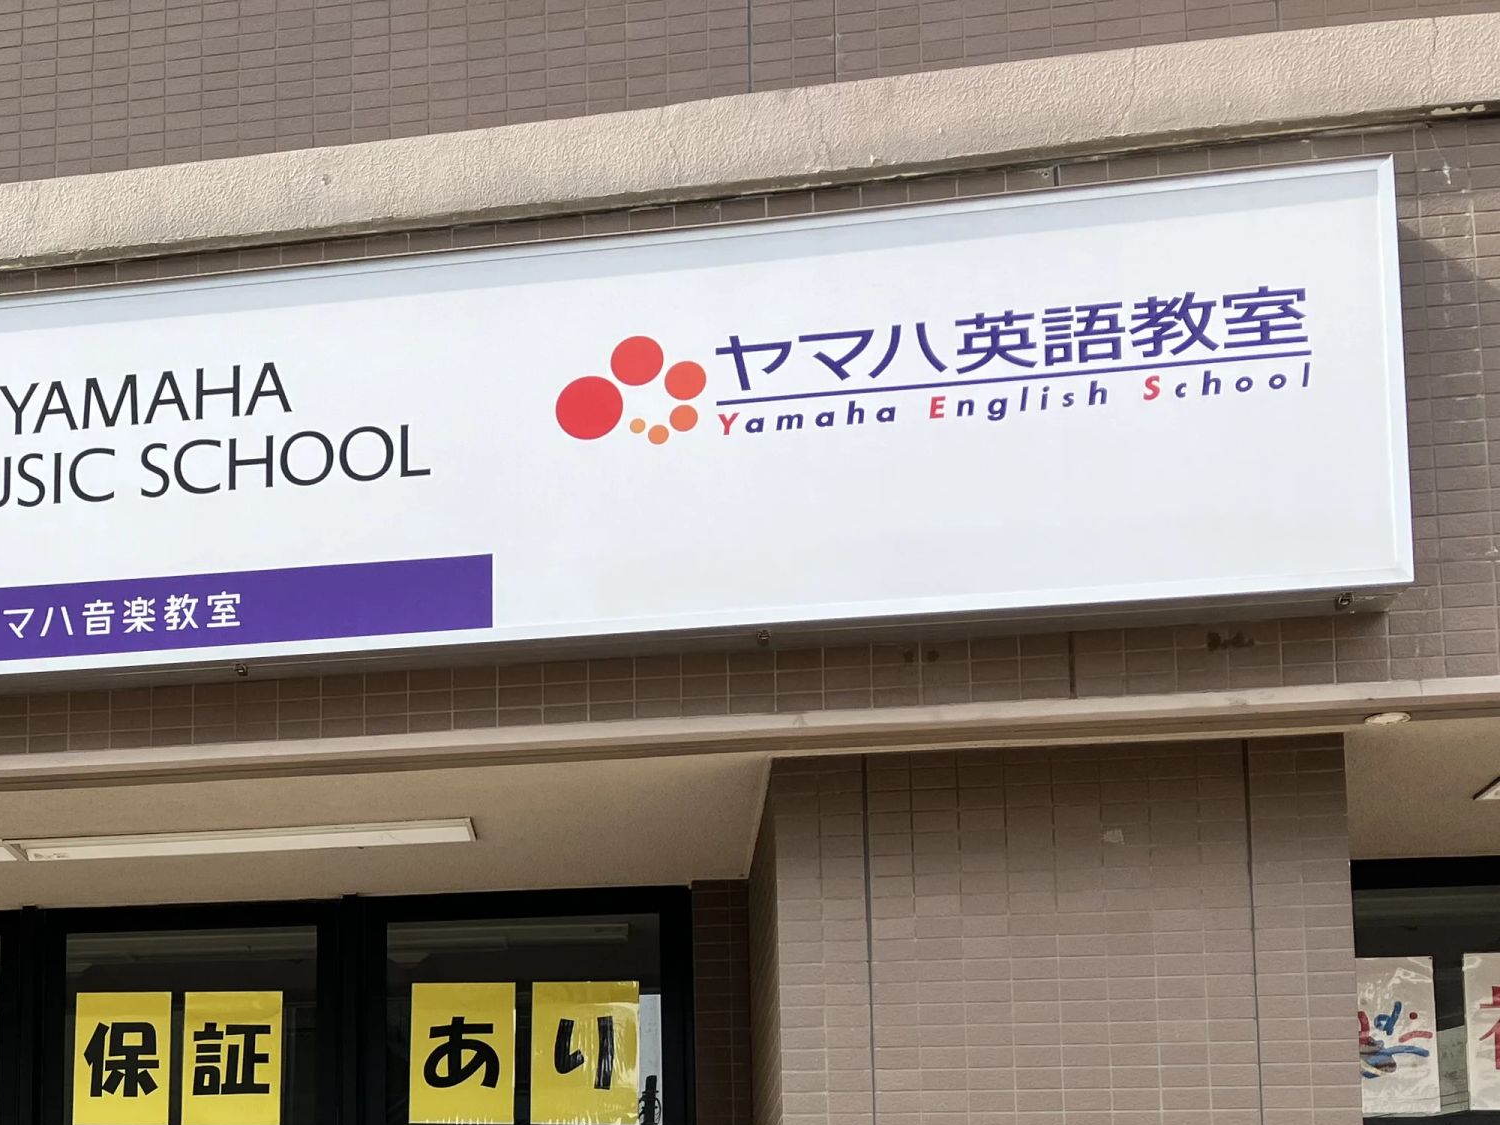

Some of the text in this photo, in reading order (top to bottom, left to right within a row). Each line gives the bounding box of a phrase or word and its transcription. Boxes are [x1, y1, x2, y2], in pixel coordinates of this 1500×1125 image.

[715, 286, 1308, 391] ヤマハ英語教室
[0, 362, 292, 435] YAMAHA
[718, 363, 1312, 436] Yamaha English School
[140, 424, 431, 499] SCHOOL
